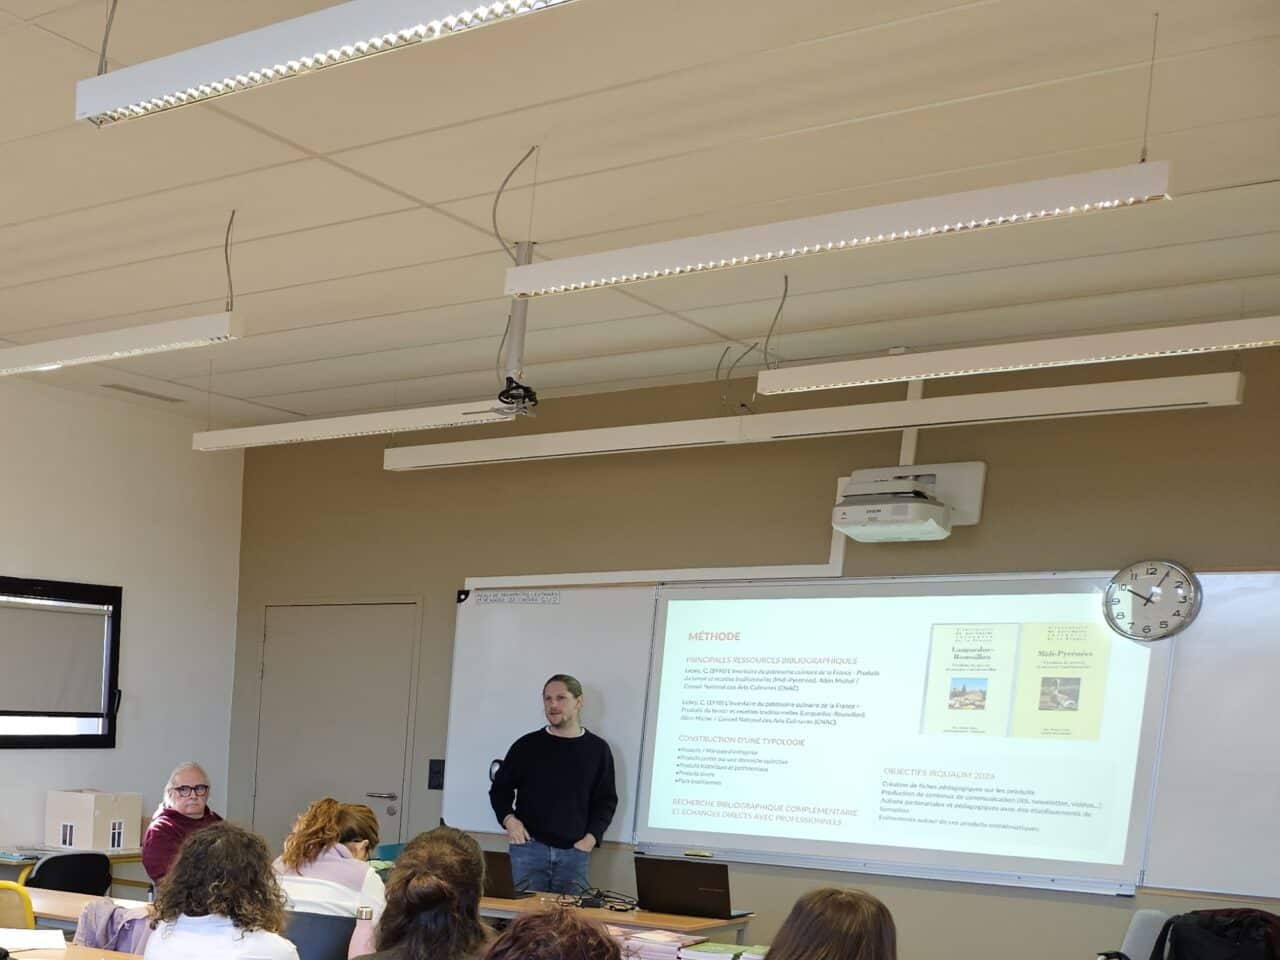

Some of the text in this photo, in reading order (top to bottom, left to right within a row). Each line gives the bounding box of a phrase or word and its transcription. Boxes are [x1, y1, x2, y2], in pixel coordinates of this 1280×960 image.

[1146, 567, 1158, 576] 12
[1174, 580, 1184, 588] 2
[1111, 597, 1121, 606] 9
[1178, 595, 1188, 604] 3
[1171, 609, 1181, 617] 4
[1142, 624, 1152, 634] 6
[1159, 620, 1169, 629] 5
[688, 630, 741, 641] MÉTHODE
[686, 656, 857, 665] PRINCIPALES RESSOURCES BIBLIOGRAPHIQUES
[678, 734, 805, 747] CONSTRUCTION D'UNE TYPOLOGIE
[884, 768, 927, 777] OBJECTIFS
[673, 797, 716, 808] RECHERCHE
[717, 800, 783, 812] BIBLIOGRAPHIQUE
[672, 808, 680, 816] ET
[722, 810, 752, 820] DIRECTS
[754, 812, 773, 821] AVEC
[775, 813, 842, 825] PROFESSIONNELS
